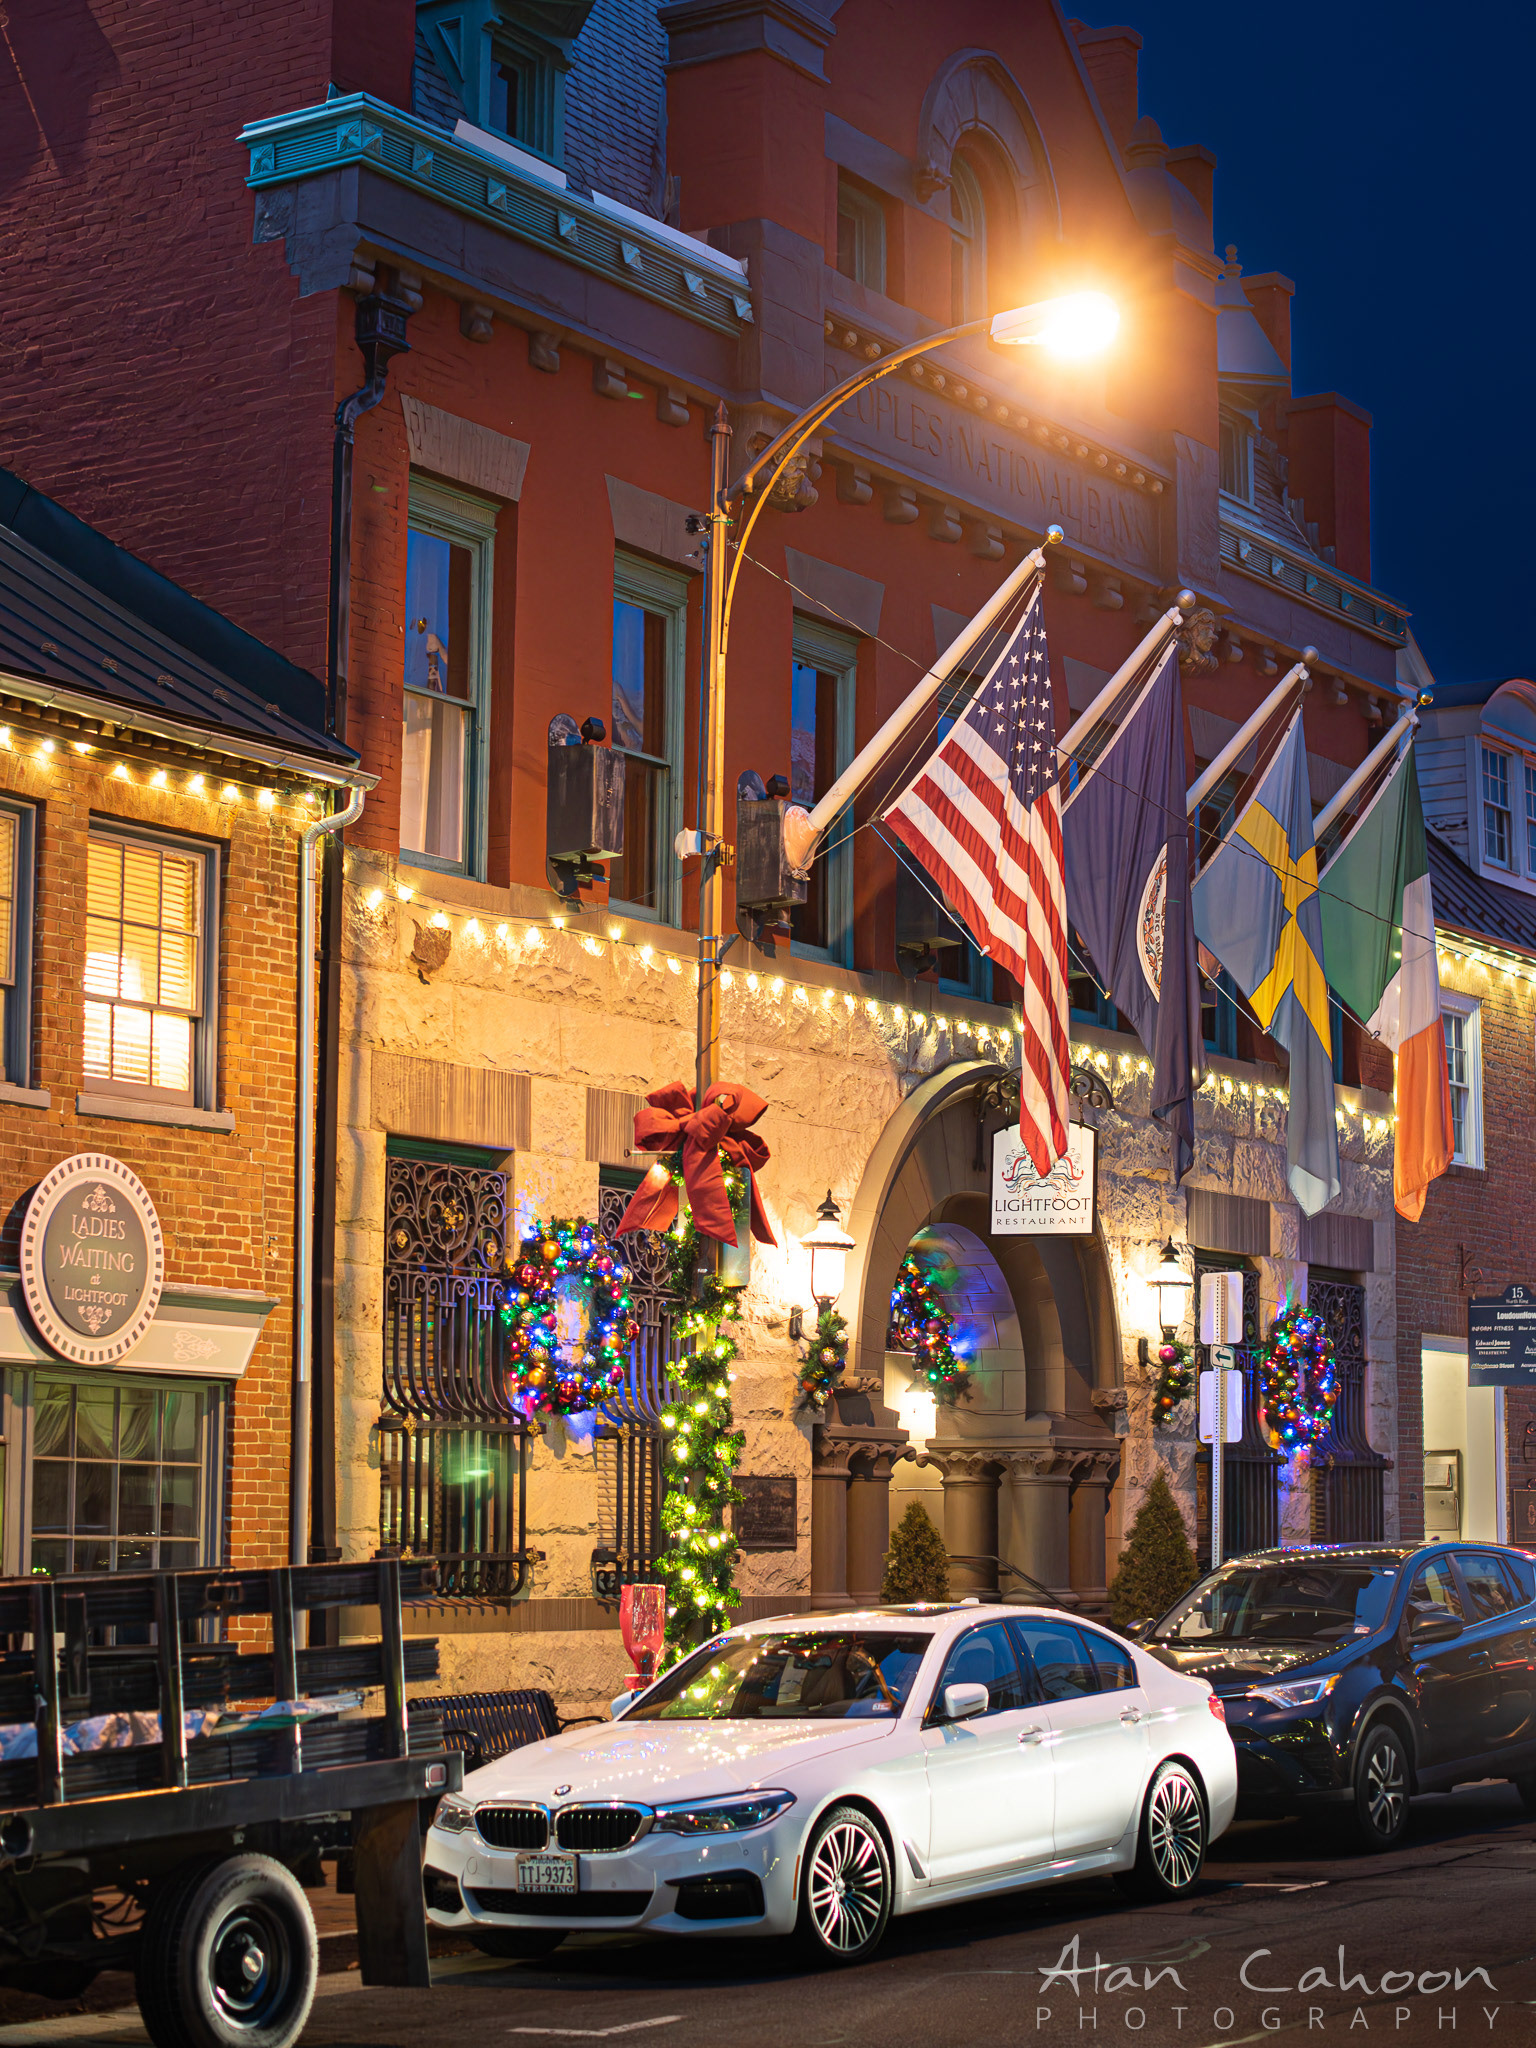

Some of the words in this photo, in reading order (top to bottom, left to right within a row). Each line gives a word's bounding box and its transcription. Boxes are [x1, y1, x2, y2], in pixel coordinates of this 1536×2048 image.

[958, 424, 1081, 521] NATIONAL
[995, 1198, 1091, 1212] LIGHTFOOT
[72, 1214, 125, 1240] LADIES
[996, 1217, 1086, 1225] RESTAURANT
[59, 1241, 135, 1273] WAITING
[90, 1274, 101, 1285] at
[64, 1285, 128, 1306] LIGHTFOOT
[1512, 1287, 1523, 1298] 15
[520, 1866, 573, 1884] TTJ-9373
[518, 1885, 574, 1893] STERLING
